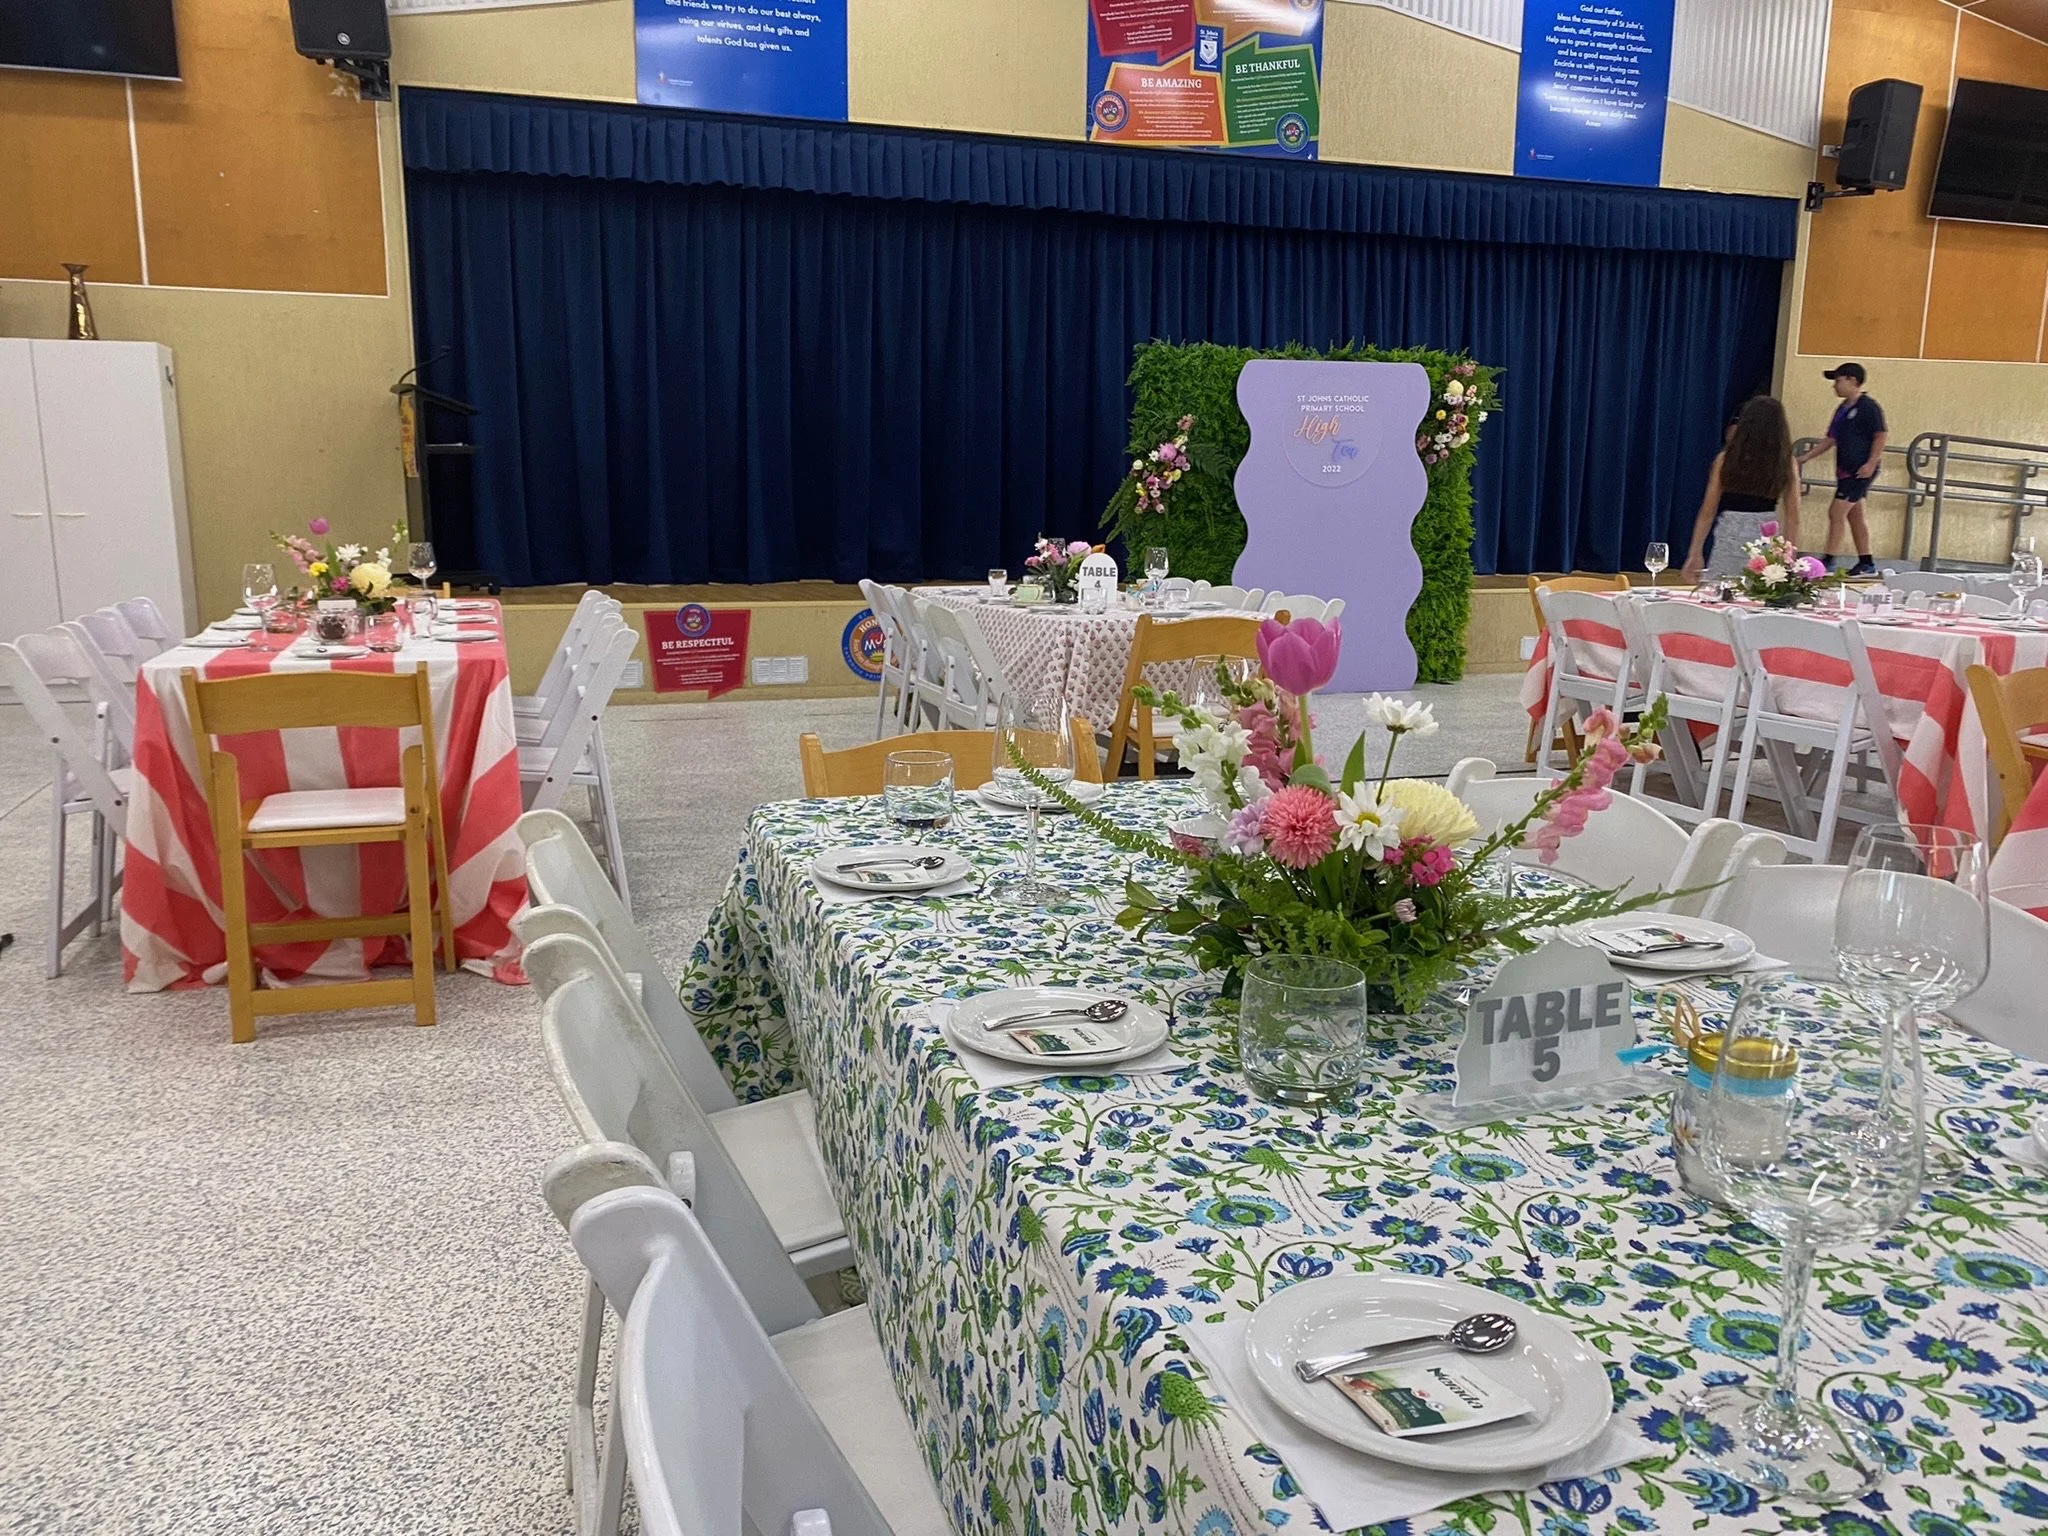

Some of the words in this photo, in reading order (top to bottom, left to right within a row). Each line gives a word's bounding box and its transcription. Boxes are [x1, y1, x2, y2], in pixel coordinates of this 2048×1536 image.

[683, 0, 709, 9] friends
[725, 4, 736, 14] try
[738, 6, 746, 14] to
[748, 6, 758, 15] do
[775, 8, 791, 18] best
[793, 12, 821, 23] always,
[1580, 4, 1593, 13] God
[678, 16, 699, 27] using
[717, 20, 744, 31] virtues,
[746, 24, 761, 32] and
[763, 25, 775, 33] the
[777, 26, 793, 36] gifts
[795, 28, 810, 37] and
[1557, 13, 1571, 21] bless
[1582, 18, 1610, 27] community
[697, 35, 722, 45] talents
[724, 37, 741, 46] God
[744, 39, 757, 48] has
[759, 42, 779, 51] given
[1546, 35, 1559, 44] Help
[1596, 42, 1617, 50] strength
[1626, 44, 1652, 53] Christians
[1599, 54, 1622, 62] example
[1235, 64, 1248, 74] BE
[1249, 59, 1300, 72] THANKFUL
[1554, 59, 1575, 68] Encircle
[1610, 65, 1626, 75] loving
[1141, 78, 1155, 87] BE
[1156, 78, 1202, 88] AMAZING
[1555, 71, 1568, 79] May
[1600, 75, 1614, 84] faith,
[1570, 85, 1609, 94] commandment
[1618, 100, 1633, 108] loved
[1293, 414, 1340, 444] High
[1082, 567, 1116, 577] TABLE
[1094, 580, 1101, 590] 4
[1862, 594, 1892, 604] TABLE
[661, 641, 675, 650] BE
[675, 637, 734, 649] RESPECTFUL
[1476, 982, 1624, 1046] TABLE
[1531, 1036, 1561, 1082] 5
[1426, 1368, 1483, 1409] Nerada
